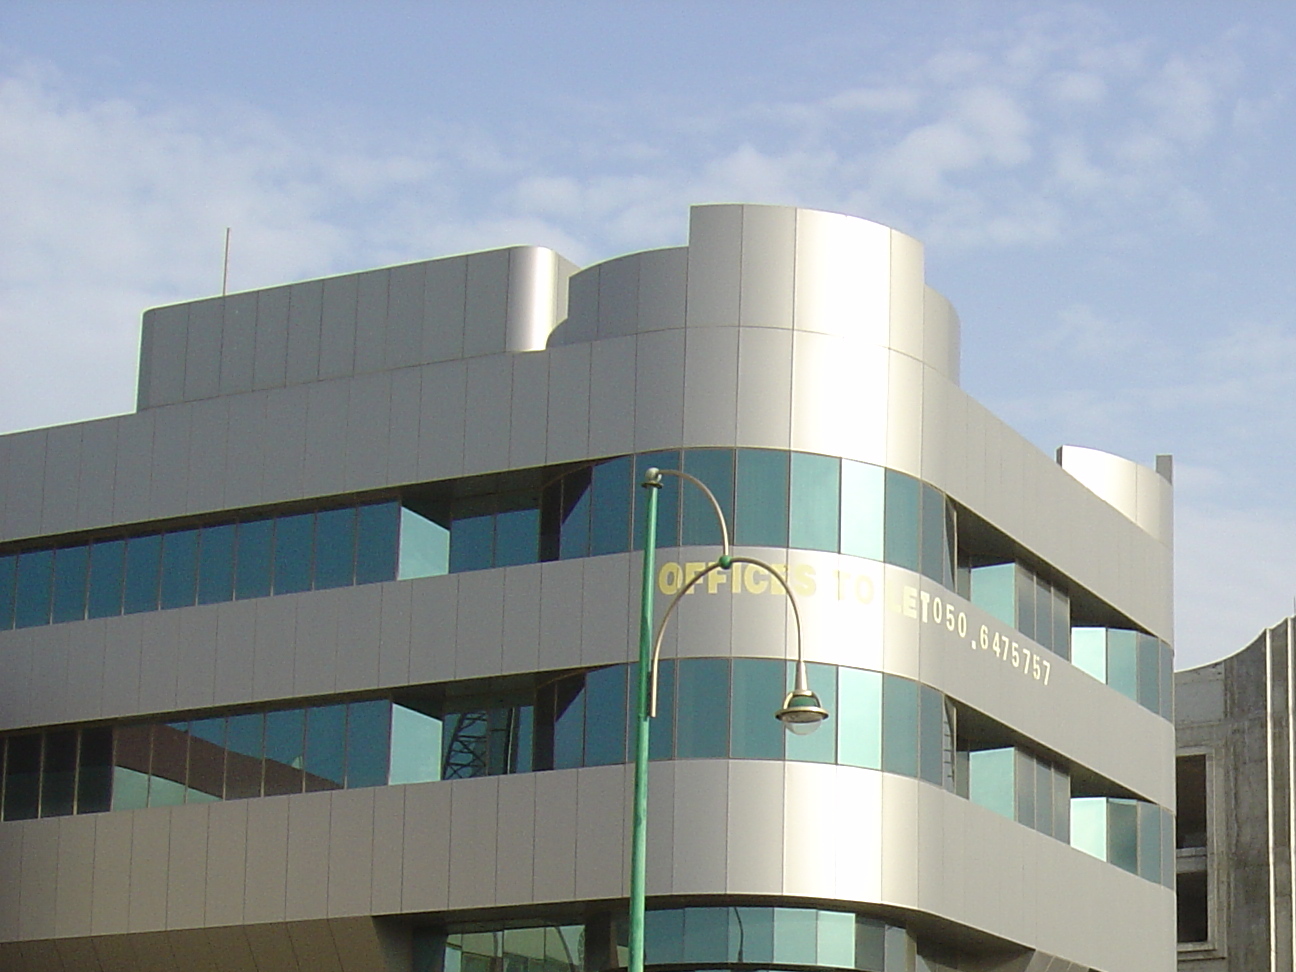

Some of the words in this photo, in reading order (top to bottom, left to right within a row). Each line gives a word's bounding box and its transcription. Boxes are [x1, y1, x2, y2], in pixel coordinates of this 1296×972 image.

[658, 562, 817, 598] OFFICES
[833, 569, 875, 605] TO
[885, 581, 931, 623] LET
